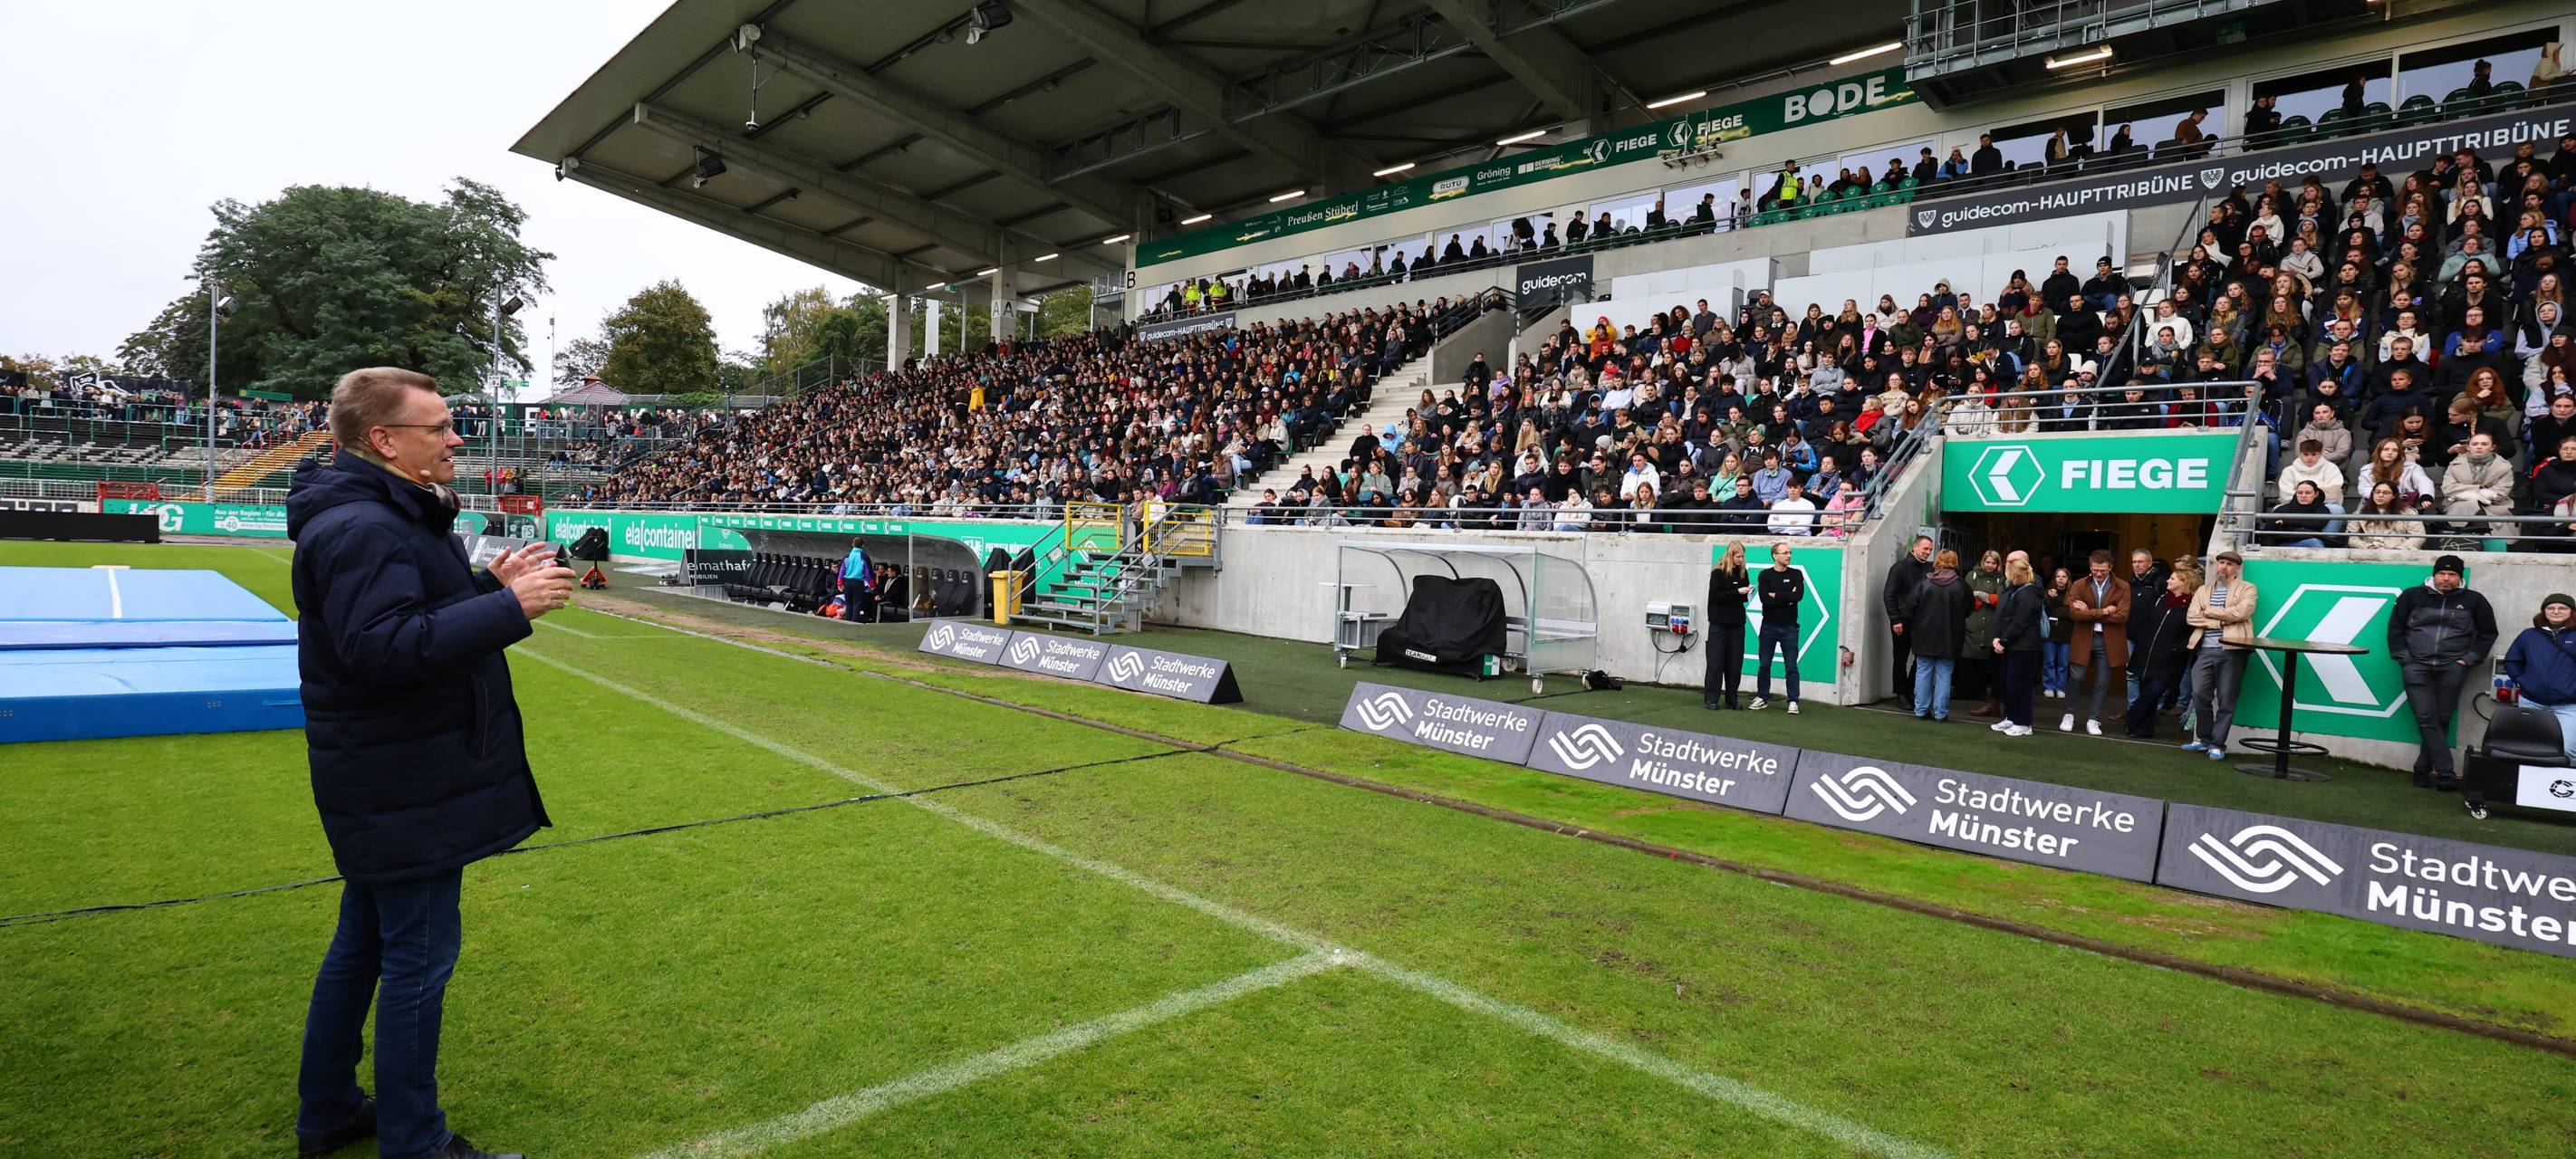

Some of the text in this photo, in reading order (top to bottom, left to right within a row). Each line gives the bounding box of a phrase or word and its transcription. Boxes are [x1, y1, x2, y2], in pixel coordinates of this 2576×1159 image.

[1697, 114, 1744, 136] FIEGE
[1616, 133, 1657, 153] FIEGE
[2231, 118, 2571, 187] guidecom-HAUPTTRIBÜNE
[1477, 167, 1511, 180] Gröning
[1941, 174, 2194, 227] guidecom-HAUPTTRIBÜNE
[1287, 211, 1323, 226] Preußen
[1325, 201, 1359, 218] Stüberl
[1127, 271, 1136, 289] B
[1522, 272, 1587, 295] guidecom
[992, 303, 1000, 316] A
[1003, 302, 1014, 318] A
[1147, 320, 1225, 341] guidecom-HAUPTTRIBÜNE
[2061, 457, 2209, 489] FIEGE
[958, 628, 1004, 647] Stadtwerke
[952, 643, 987, 659] Münster
[1045, 639, 1100, 661] Stadtwerke
[1038, 655, 1080, 674] Münster
[1150, 656, 1216, 678] Stadtwerke
[1142, 672, 1194, 694] Münster
[1423, 698, 1528, 732] Stadtwerke
[1415, 720, 1495, 750] Münster
[1637, 732, 1778, 776] Stadtwerke
[1629, 759, 1735, 797] Münster
[1934, 778, 2135, 833] Stadtwerke
[1928, 809, 2079, 857] Münster
[2369, 842, 2576, 902] Stadtwe
